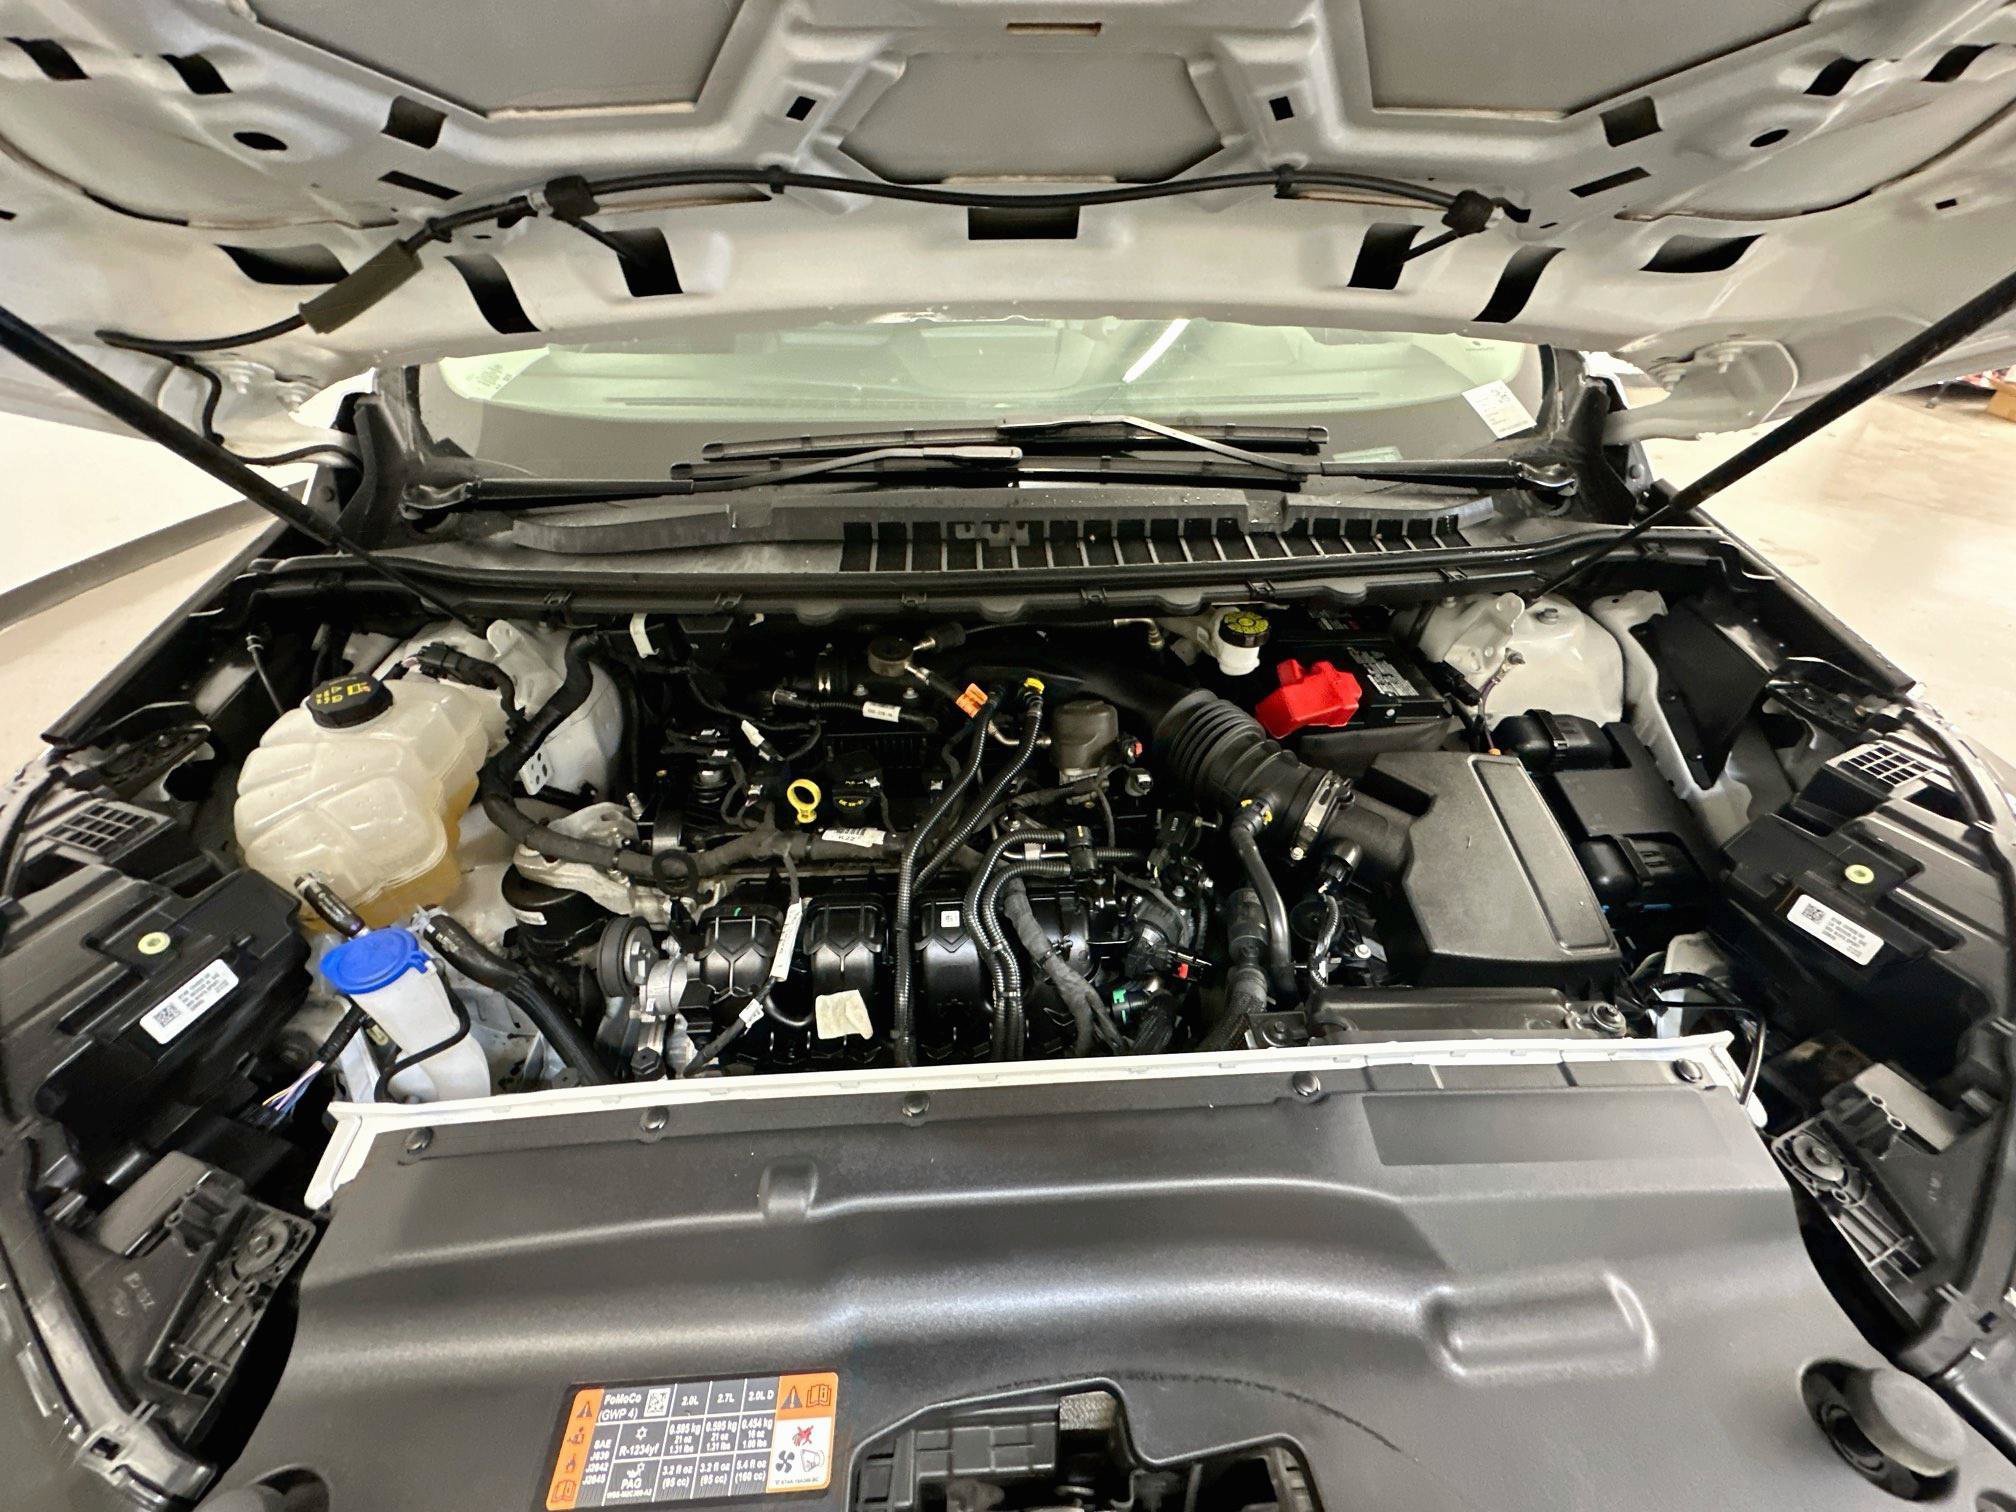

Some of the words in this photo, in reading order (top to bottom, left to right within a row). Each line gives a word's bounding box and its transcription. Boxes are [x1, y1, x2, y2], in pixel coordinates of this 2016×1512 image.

[604, 1393, 641, 1405] FoMoCo
[717, 1393, 735, 1403] 2.7L
[748, 1391, 765, 1401] 2.0L
[767, 1389, 774, 1400] D
[681, 1396, 699, 1406] 2.0L
[598, 1408, 626, 1422] (GWP
[628, 1407, 638, 1420] 4)
[691, 1422, 701, 1435] kg
[727, 1419, 737, 1432] kg
[763, 1417, 773, 1430] kg
[674, 1435, 682, 1444] 21
[711, 1433, 719, 1441] 21
[757, 1439, 767, 1448] lbs
[619, 1443, 660, 1456] R-1234yf
[700, 1463, 712, 1473] 3.2
[713, 1462, 720, 1471] fl
[720, 1462, 730, 1471] oz
[749, 1459, 756, 1469] fl
[757, 1460, 767, 1469] oz
[662, 1465, 675, 1475] 3.2
[675, 1465, 682, 1474] fl
[683, 1465, 693, 1473] oz
[676, 1476, 690, 1487] cc)
[714, 1473, 727, 1485] cc)
[753, 1471, 766, 1482] cc)
[621, 1478, 642, 1490] PAG
